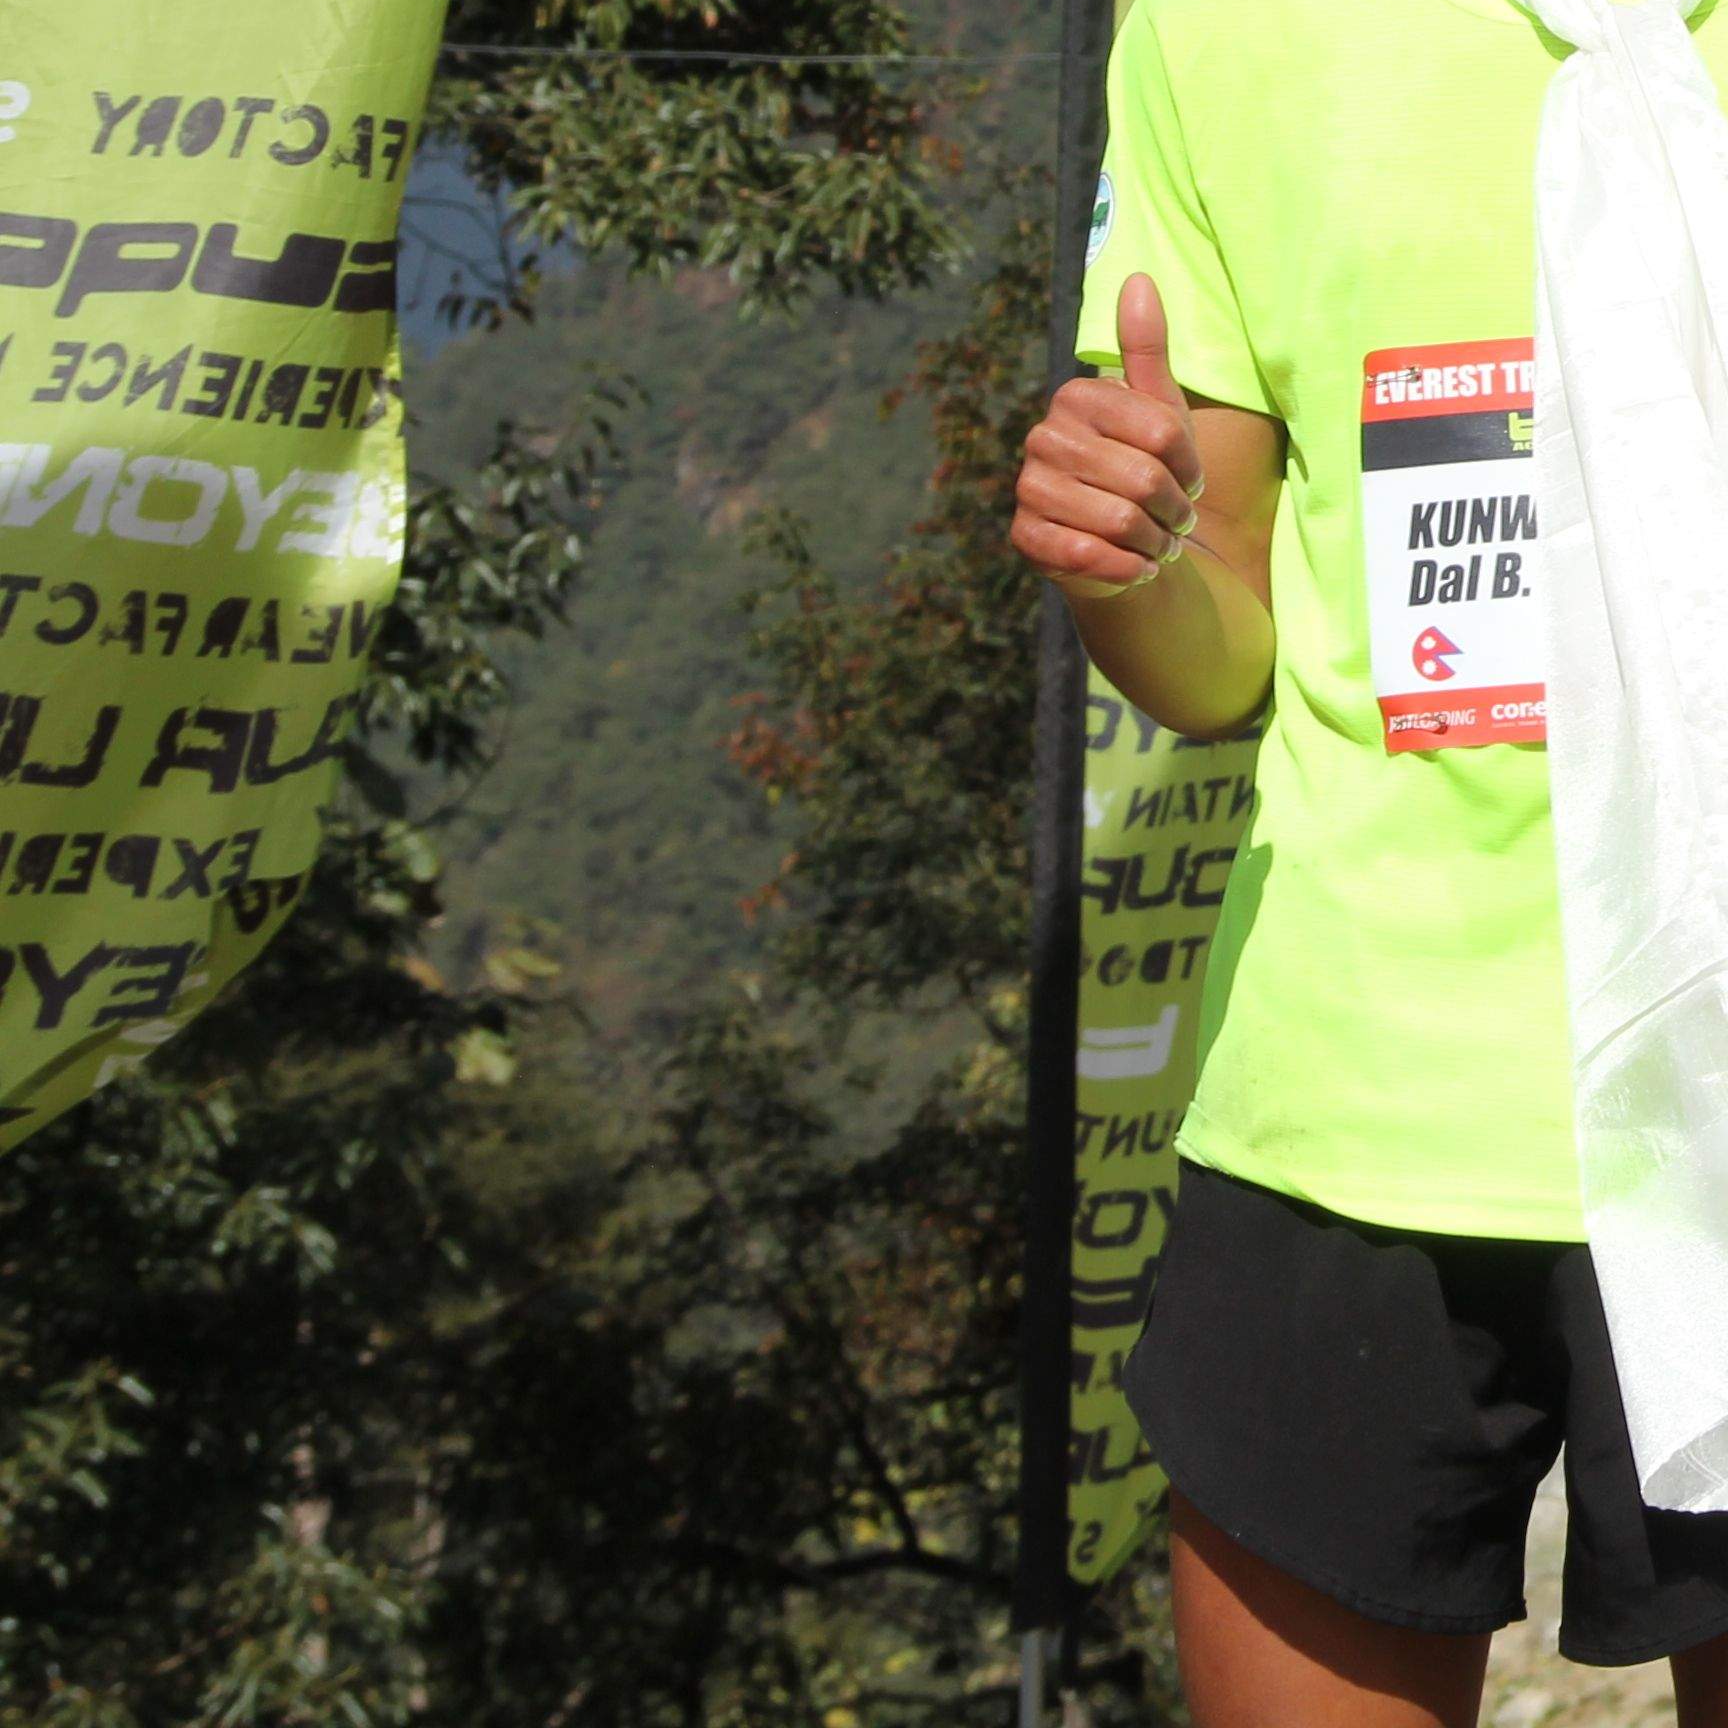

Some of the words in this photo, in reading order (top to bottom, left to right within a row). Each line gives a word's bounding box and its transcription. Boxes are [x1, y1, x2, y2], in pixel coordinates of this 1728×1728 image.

[1375, 362, 1495, 405] EVEREST
[1408, 554, 1482, 608] Dal
[1491, 551, 1531, 600] B.
